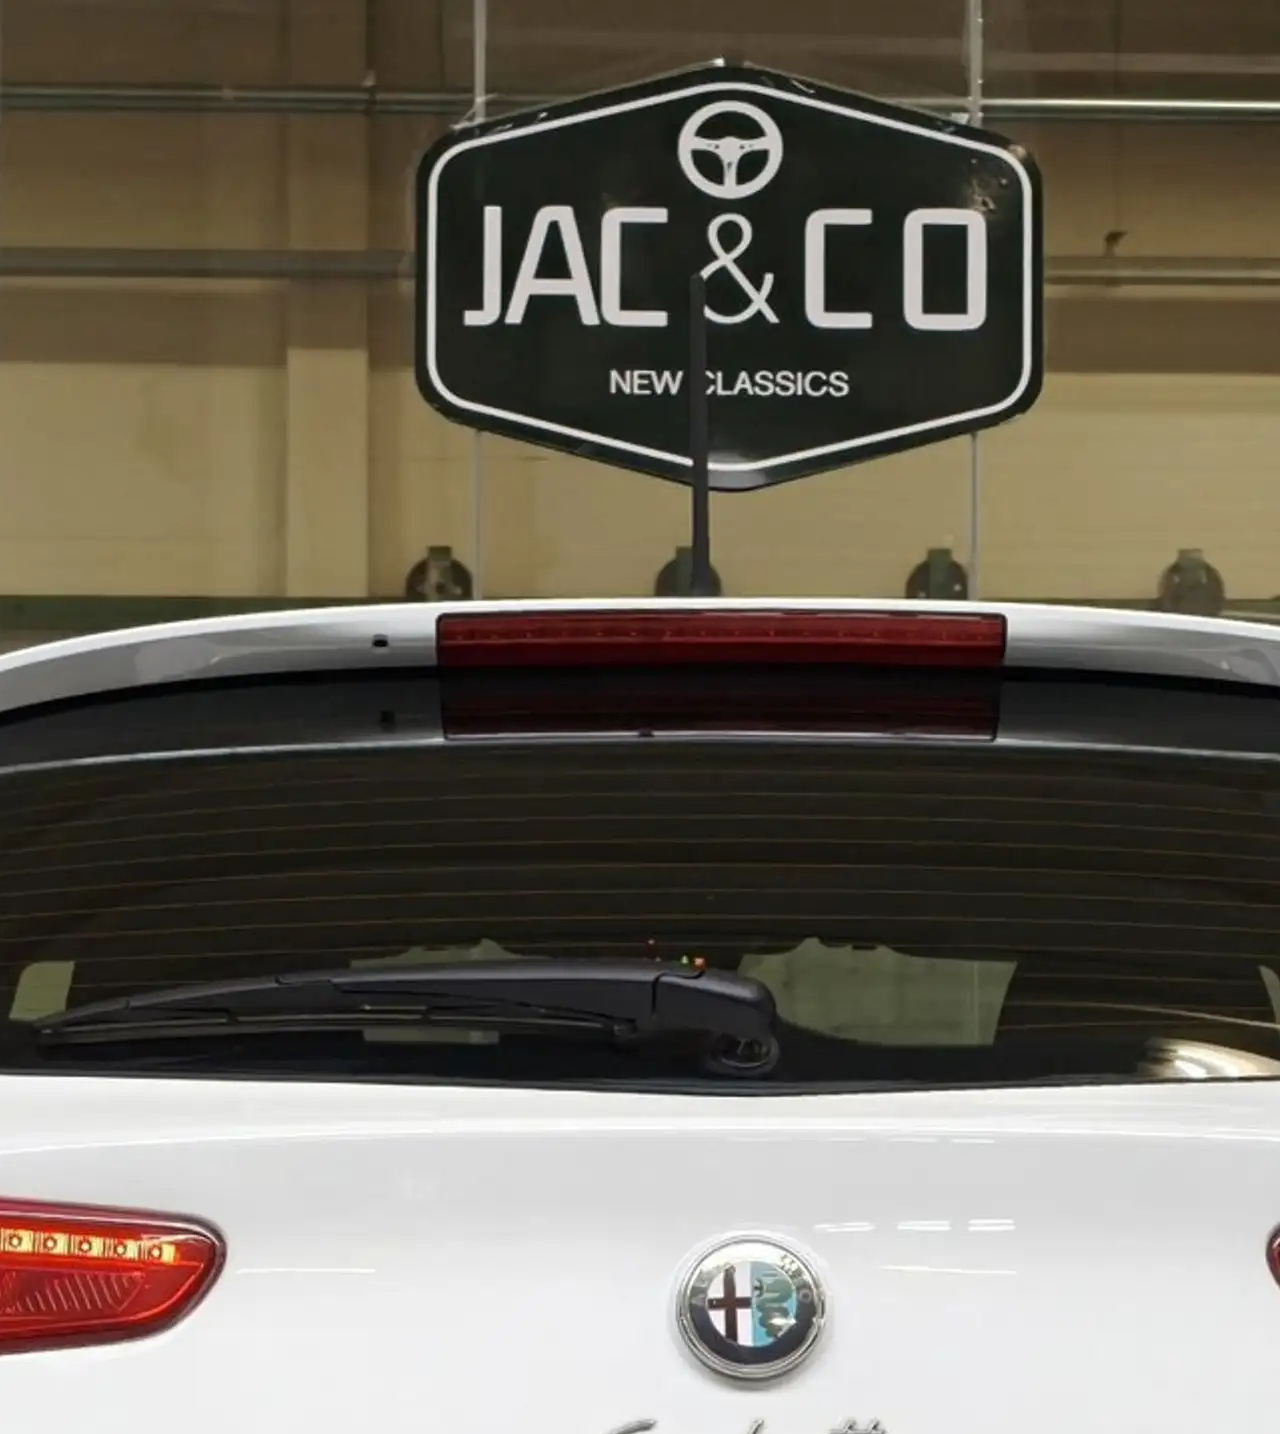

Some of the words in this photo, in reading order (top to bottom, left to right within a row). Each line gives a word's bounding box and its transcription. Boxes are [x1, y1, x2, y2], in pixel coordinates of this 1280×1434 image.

[463, 205, 669, 327] JAC
[699, 212, 780, 325] &
[804, 208, 989, 331] CO
[609, 369, 684, 396] NEW
